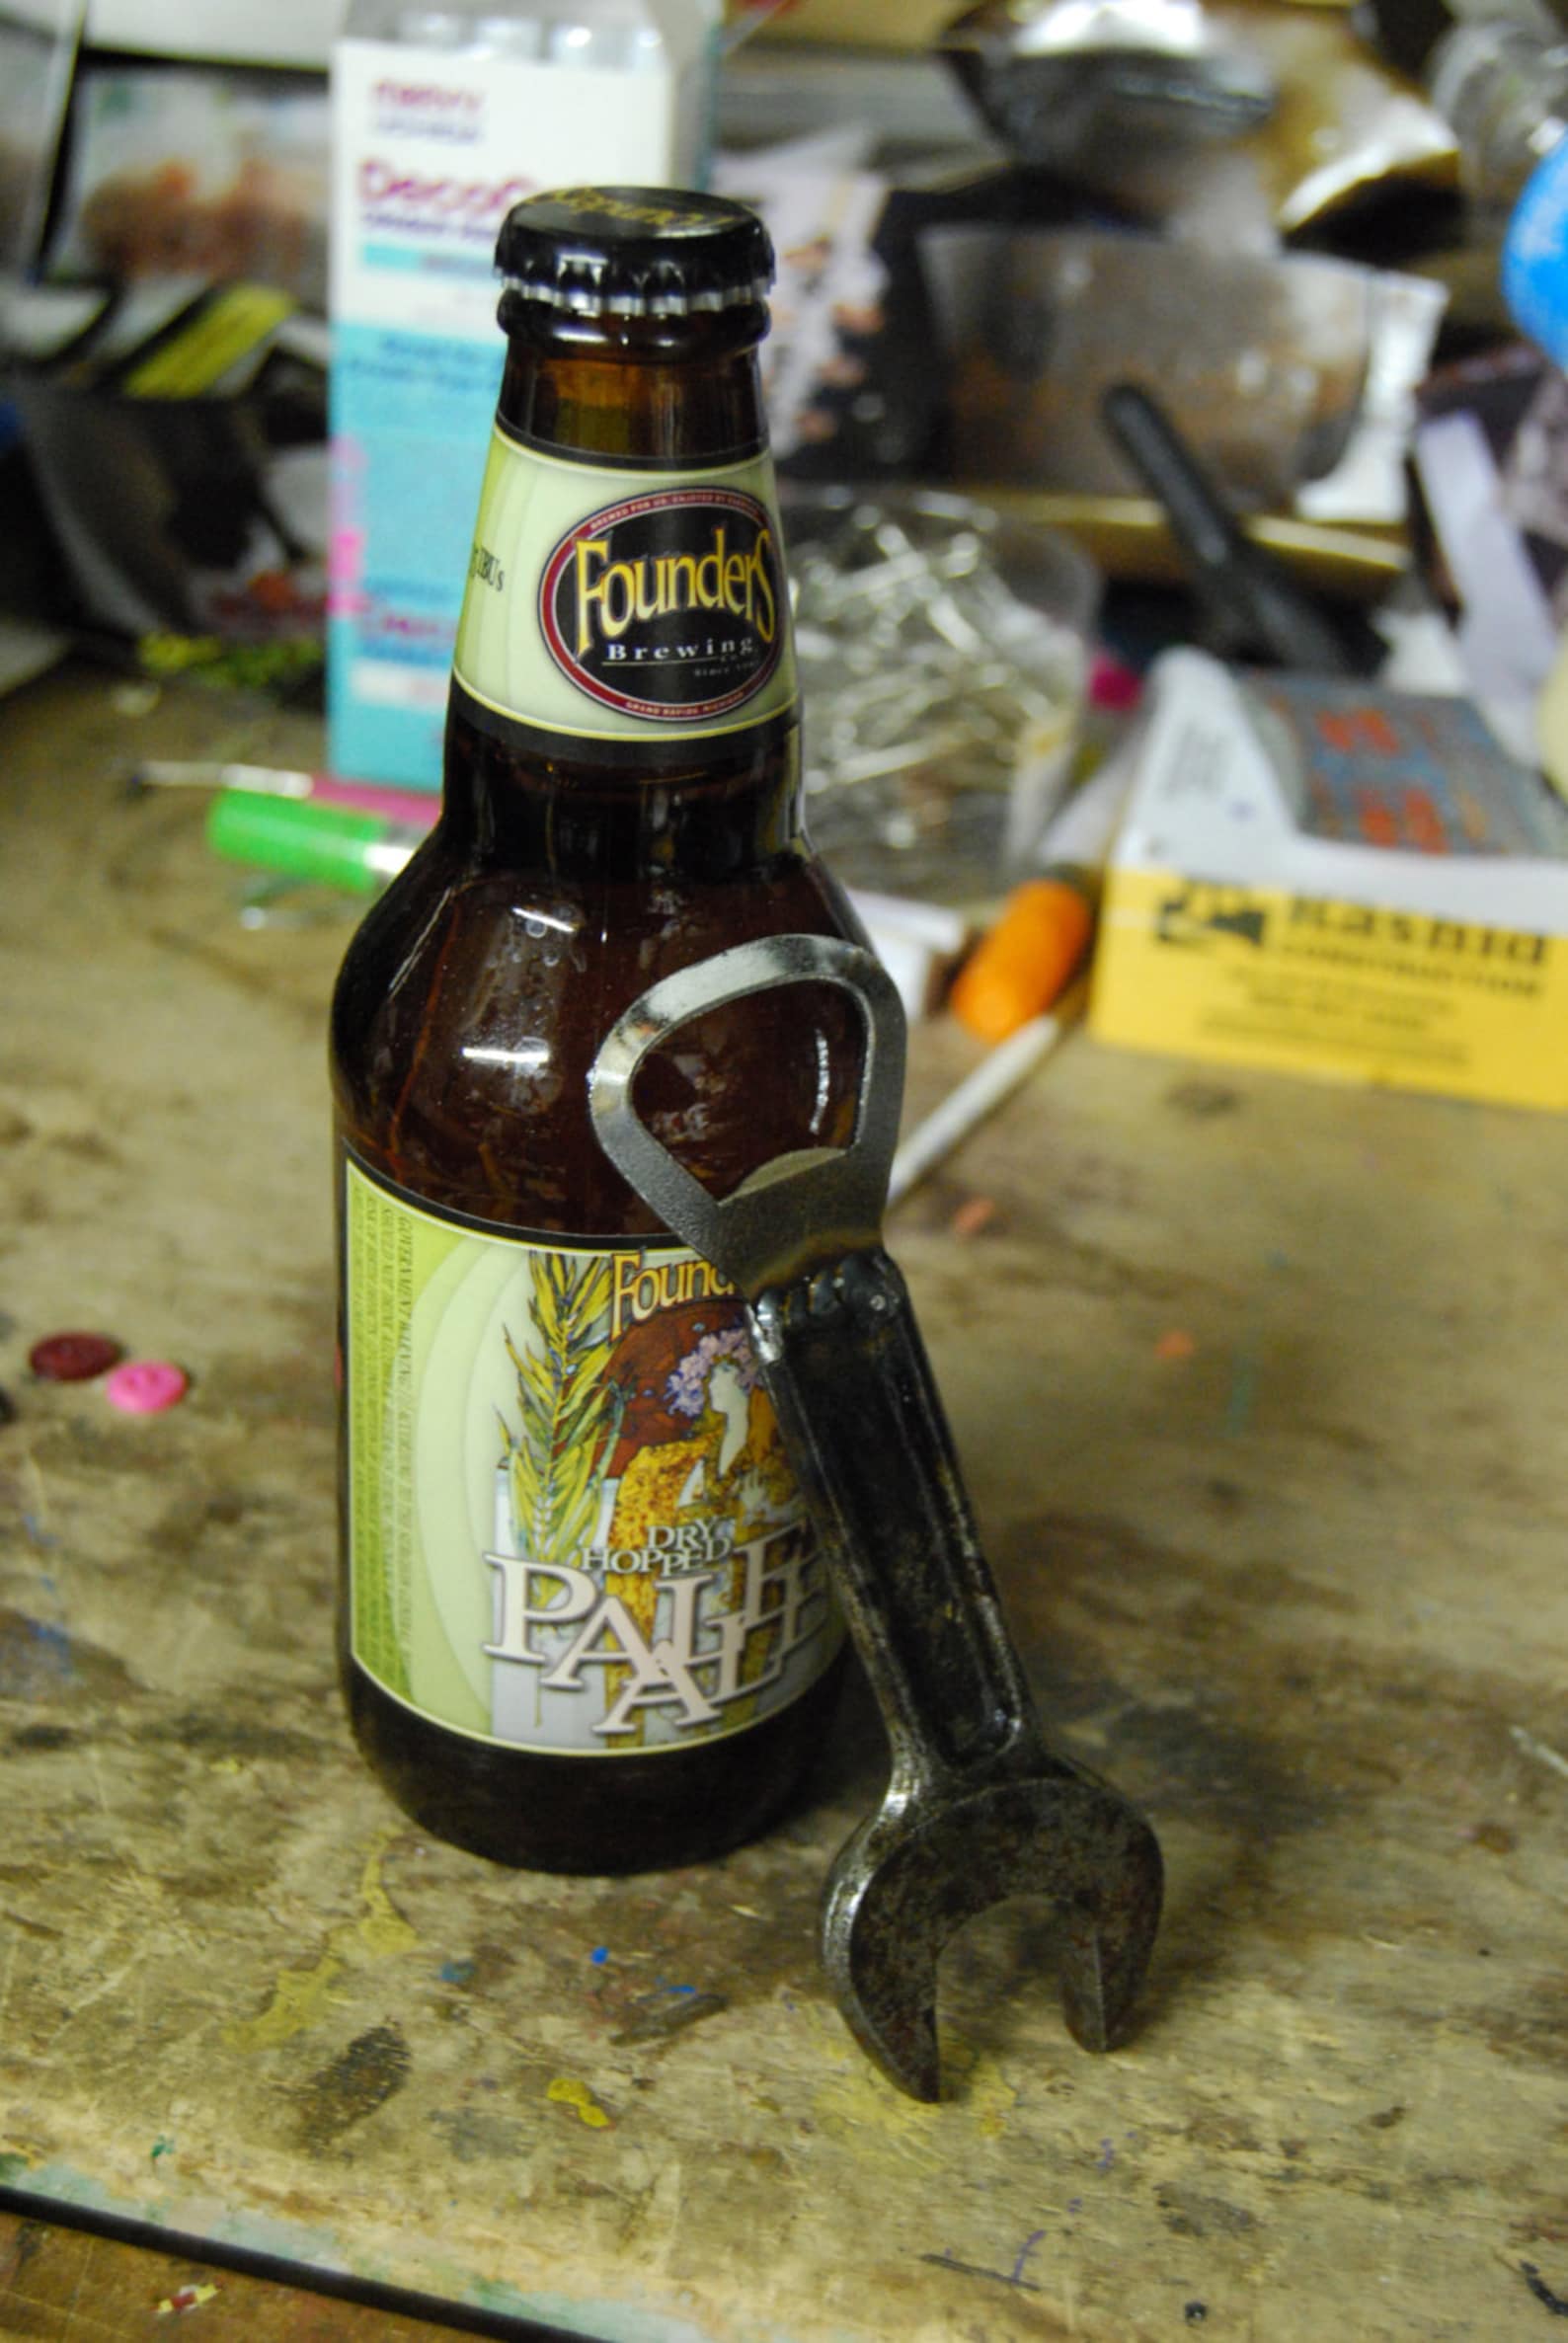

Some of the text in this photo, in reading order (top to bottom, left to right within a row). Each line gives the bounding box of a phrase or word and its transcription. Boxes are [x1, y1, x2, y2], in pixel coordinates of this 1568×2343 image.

[630, 502, 652, 511] FOR
[573, 526, 775, 658] Founders
[607, 637, 754, 661] Brewing
[647, 1518, 718, 1549] DRY
[581, 1538, 731, 1577] HOPPED
